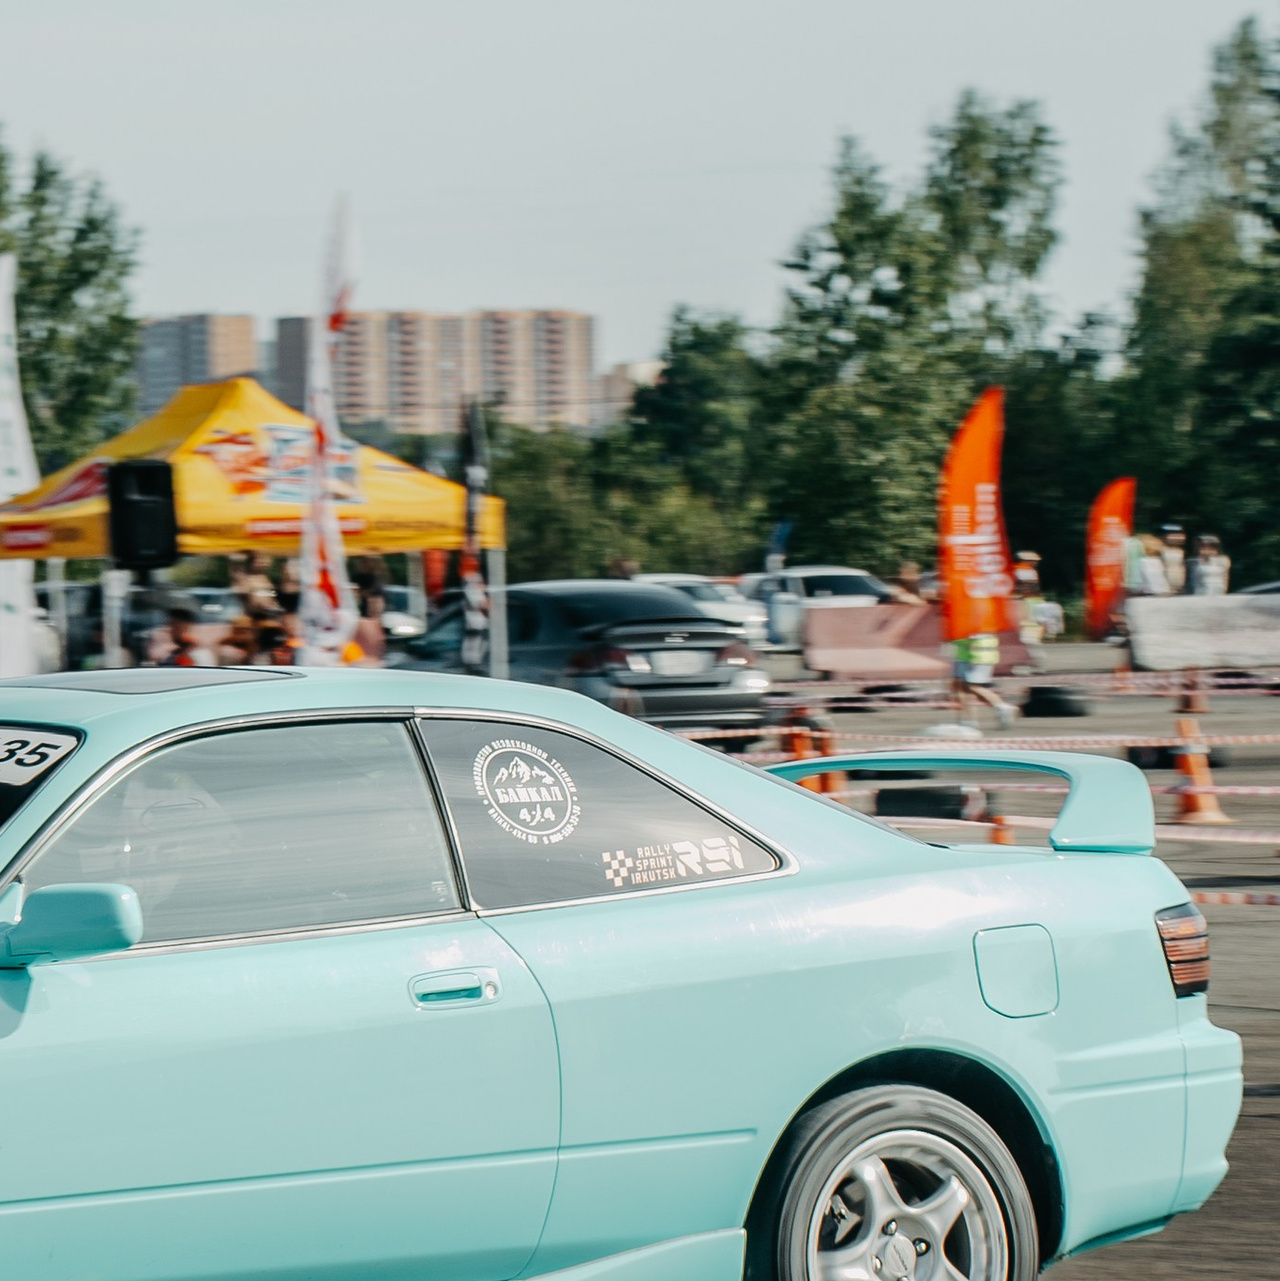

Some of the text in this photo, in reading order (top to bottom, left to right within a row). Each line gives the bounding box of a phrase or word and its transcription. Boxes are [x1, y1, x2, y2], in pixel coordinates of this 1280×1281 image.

[472, 745, 493, 796] ПРОИЗВОДСТВО
[550, 758, 578, 793] ТЕХНИКИ
[495, 784, 564, 804] БАЙКАЛ
[637, 843, 671, 858] RALLY
[671, 835, 745, 877] RSI
[636, 855, 673, 871] SPRINT
[631, 868, 677, 885] IRKUTSK
